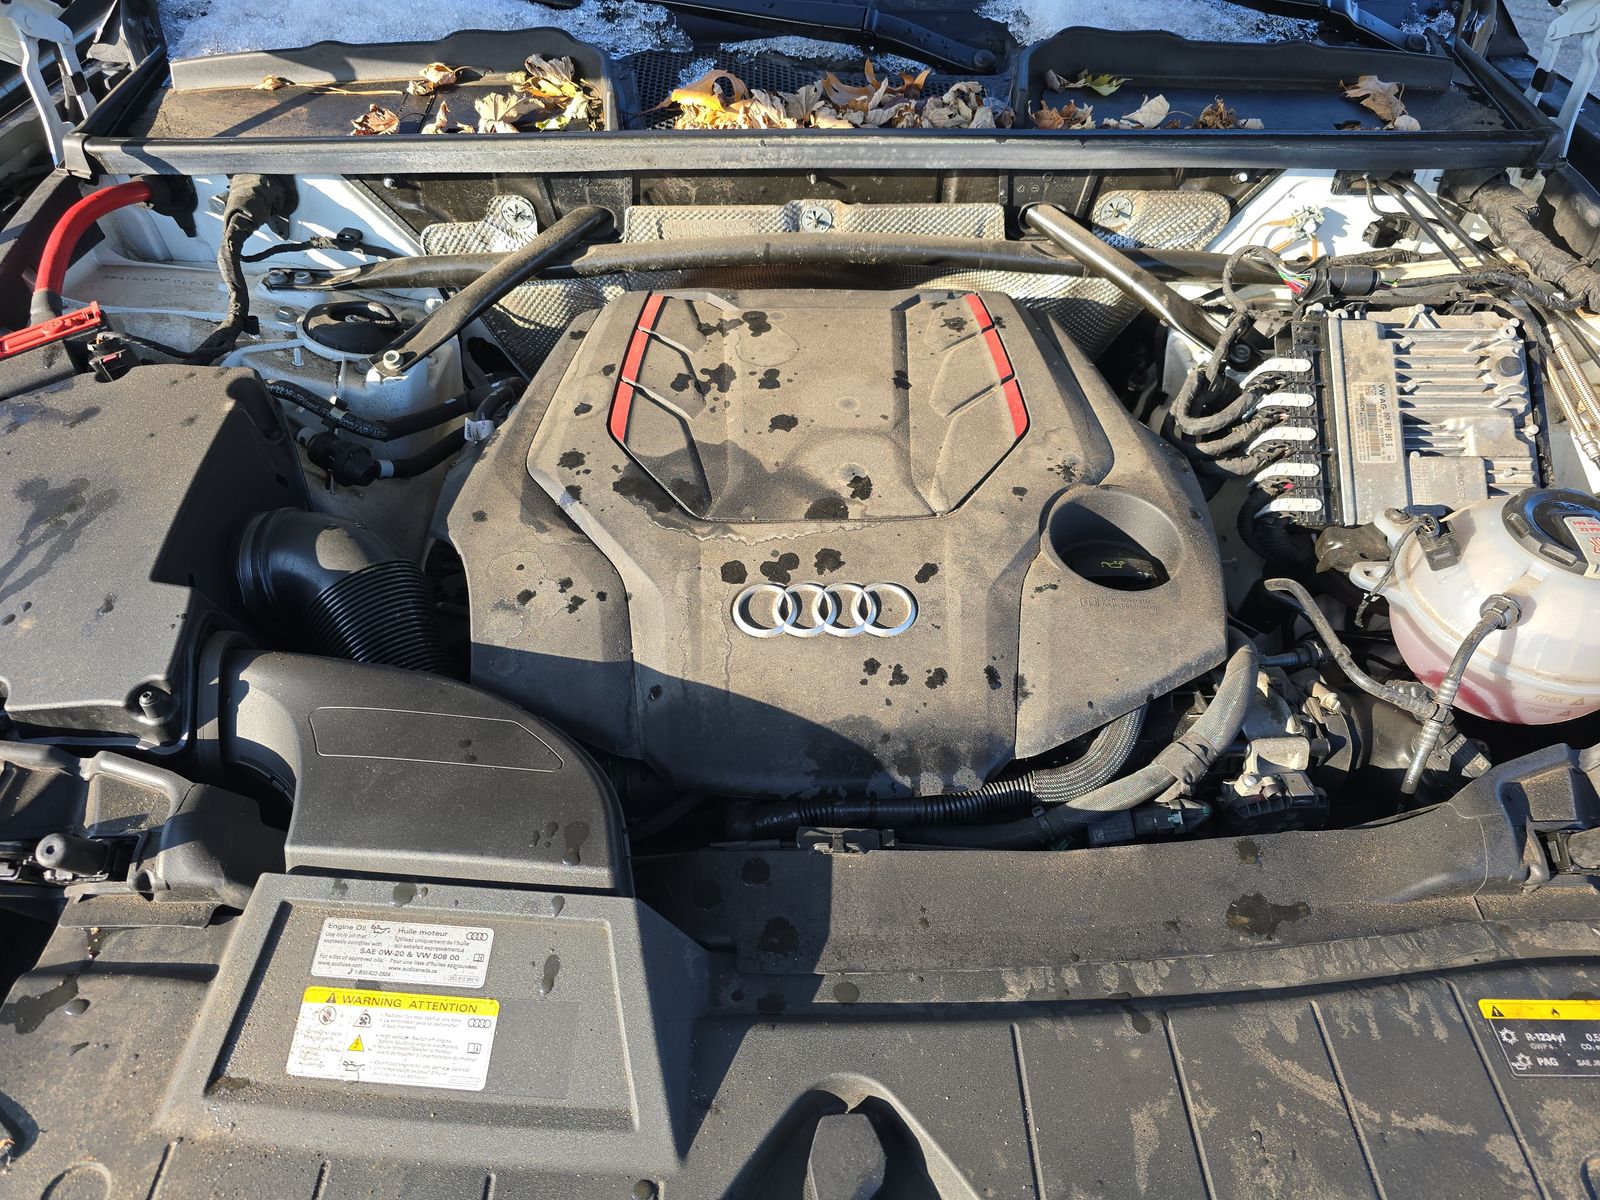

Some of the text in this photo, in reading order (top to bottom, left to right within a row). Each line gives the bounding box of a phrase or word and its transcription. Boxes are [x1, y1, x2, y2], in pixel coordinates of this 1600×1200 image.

[1379, 384, 1386, 397] VW
[1380, 398, 1387, 410] AG
[328, 923, 354, 931] Engine
[360, 947, 377, 955] SAE
[378, 949, 405, 957] 0W-20
[342, 994, 478, 1014] WARNING ATTENTION
[1524, 1032, 1566, 1043] R-1234yf
[1536, 1057, 1560, 1067] PAG
[1576, 1059, 1592, 1067] SAE
